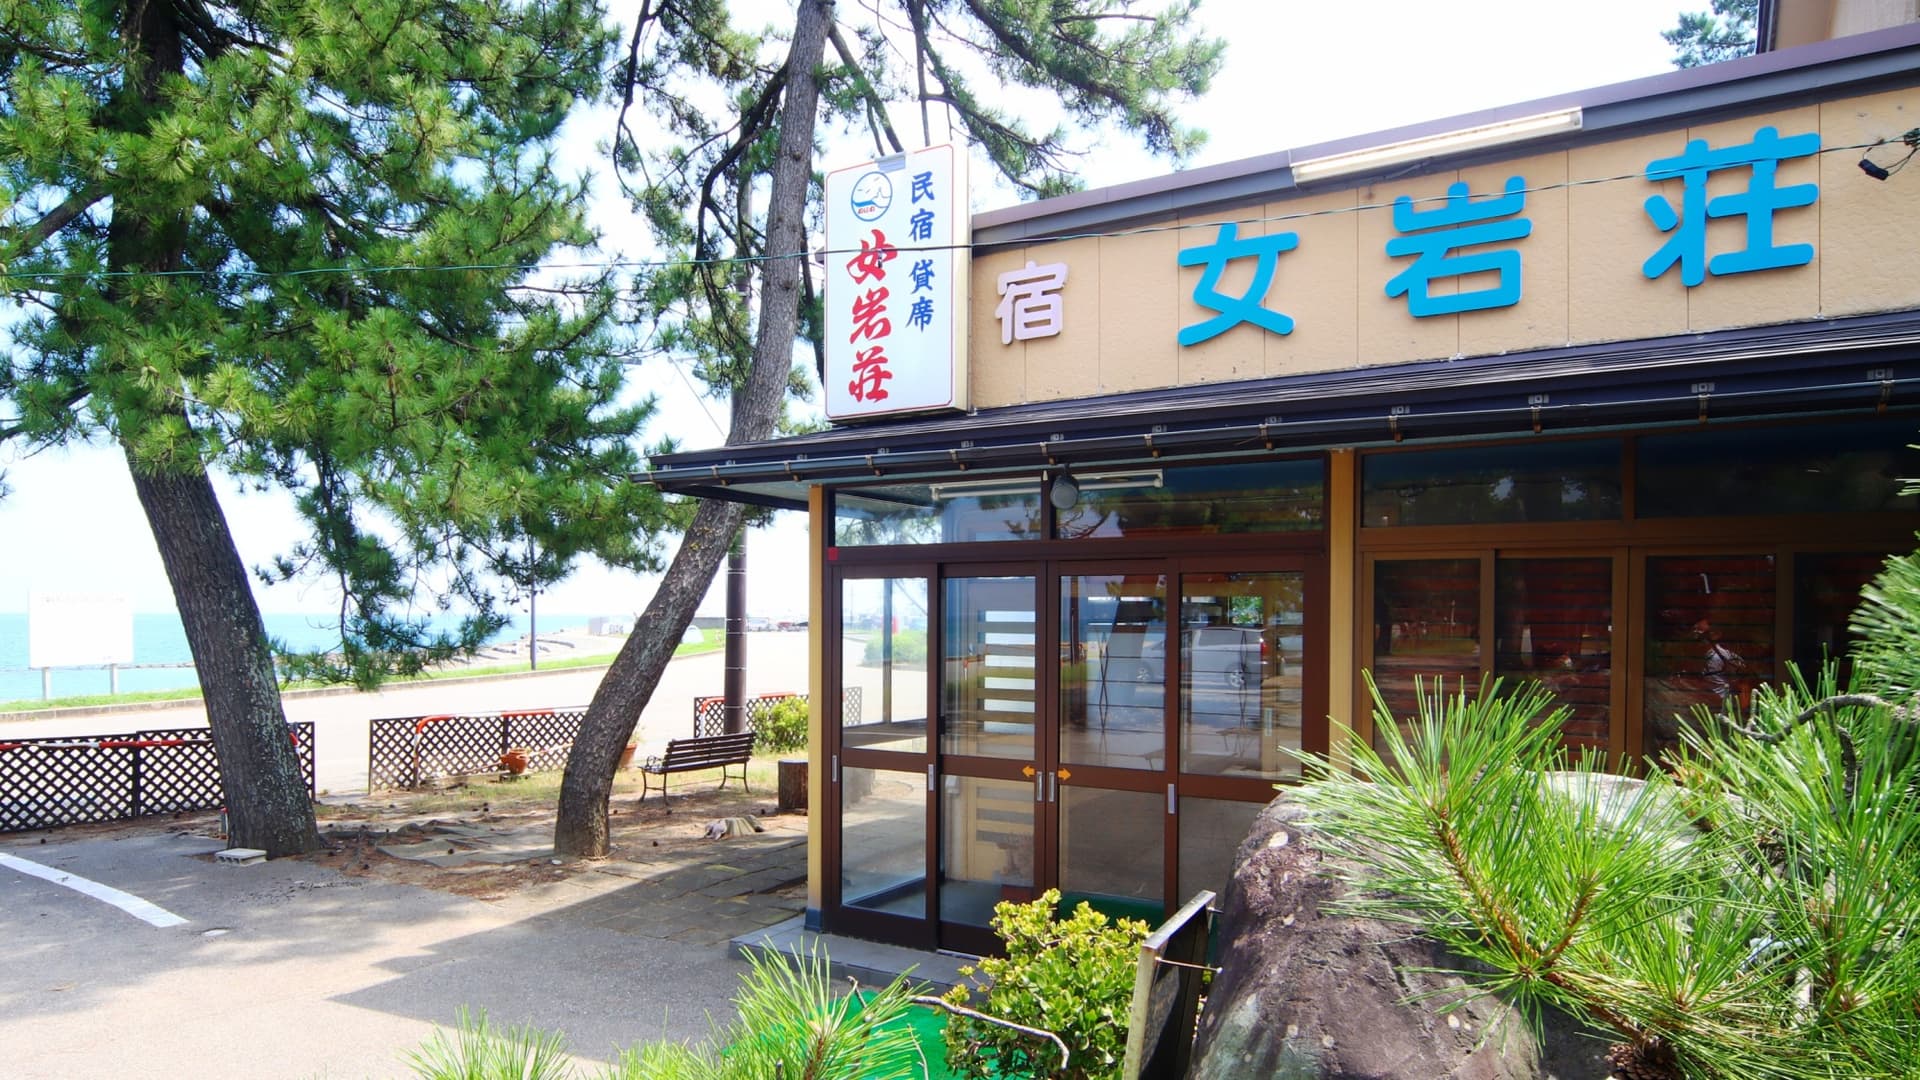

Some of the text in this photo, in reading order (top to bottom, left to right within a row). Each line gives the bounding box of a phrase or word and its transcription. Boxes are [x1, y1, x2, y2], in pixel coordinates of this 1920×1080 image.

[846, 229, 898, 402] 女岩荘
[996, 127, 1820, 346] 宿 女岩荘
